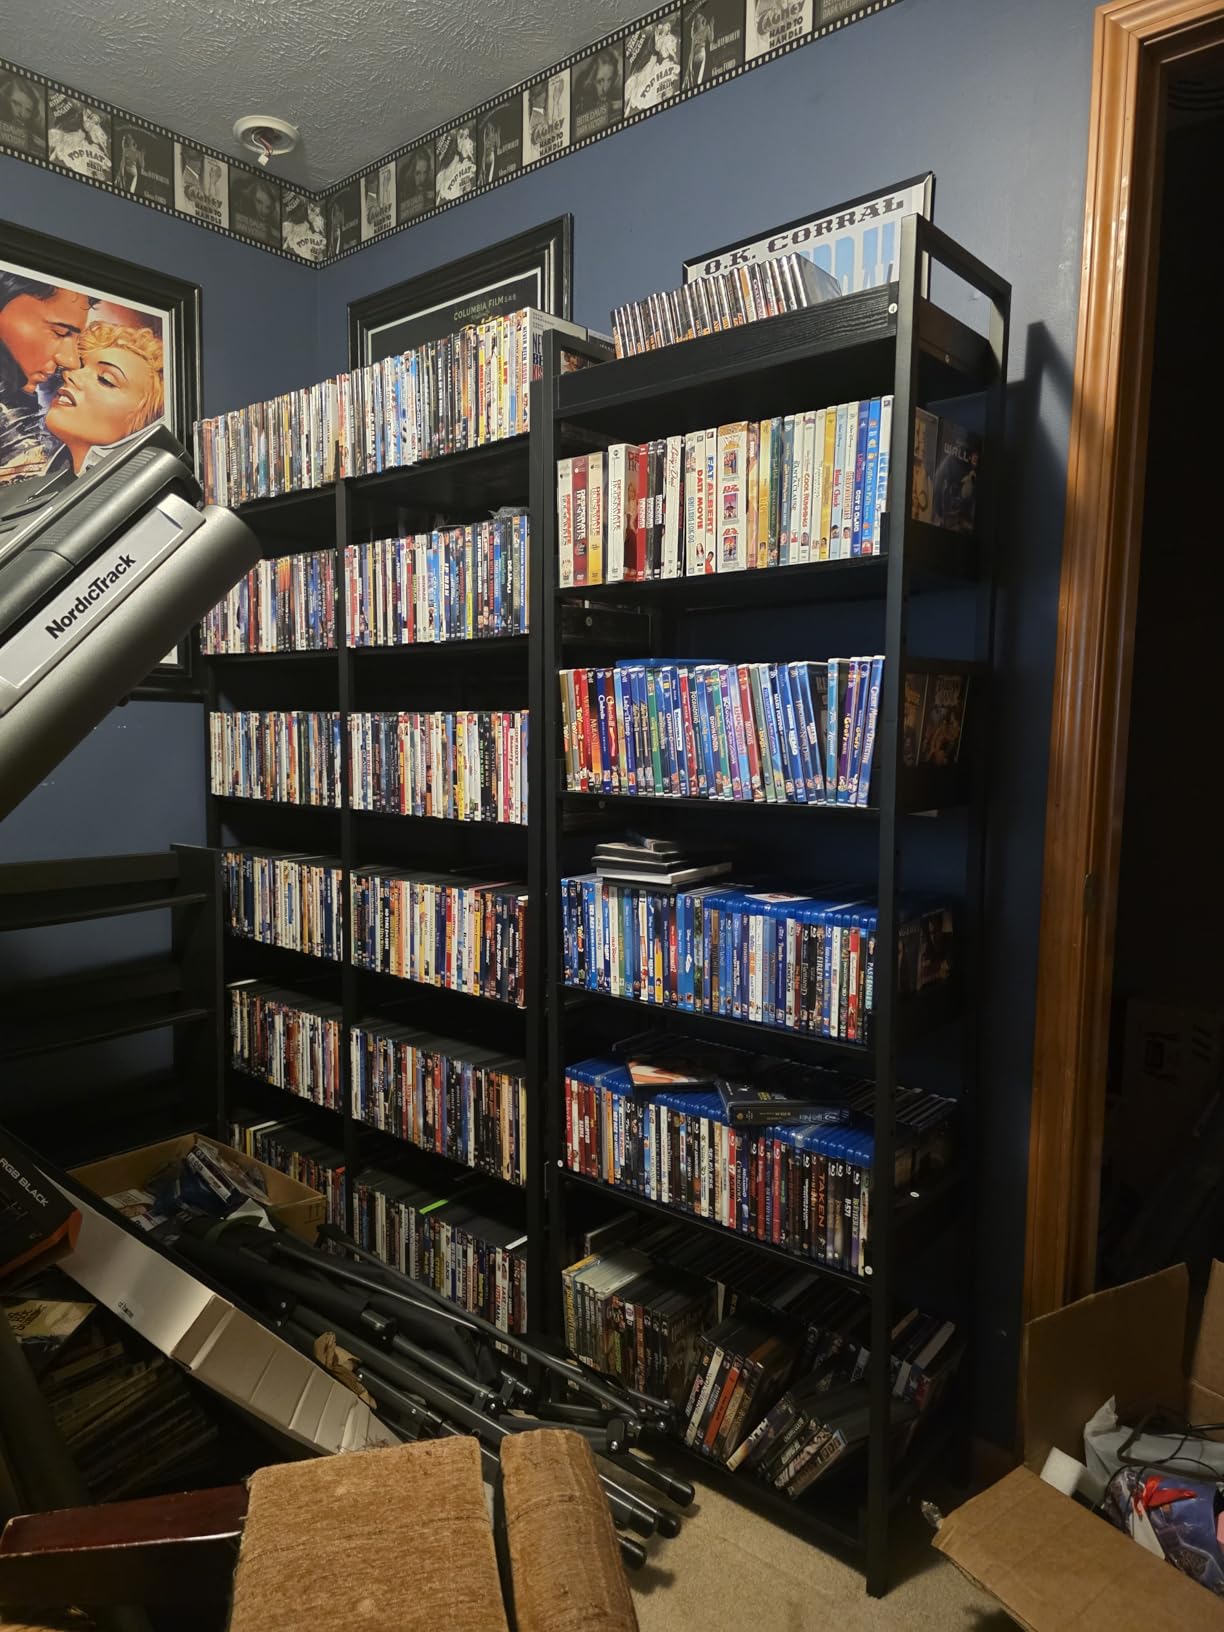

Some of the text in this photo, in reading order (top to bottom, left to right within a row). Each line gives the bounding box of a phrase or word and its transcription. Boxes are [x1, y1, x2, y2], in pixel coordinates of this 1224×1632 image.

[769, 16, 803, 38] HARD TO
[769, 27, 803, 48] HANDLE
[640, 66, 675, 98] TOP HAT
[68, 149, 86, 161] TOP
[704, 196, 904, 276] O.K. CORRAL
[453, 302, 487, 321] COLUMBIA
[488, 296, 504, 308] FILM
[803, 473, 811, 492] COOL
[706, 482, 714, 535] ALBERT
[45, 554, 136, 639] NordicTrack
[865, 962, 874, 1010] PASSENGERS
[0, 1158, 49, 1207] RGB BLACK
[729, 1164, 735, 1175] 17
